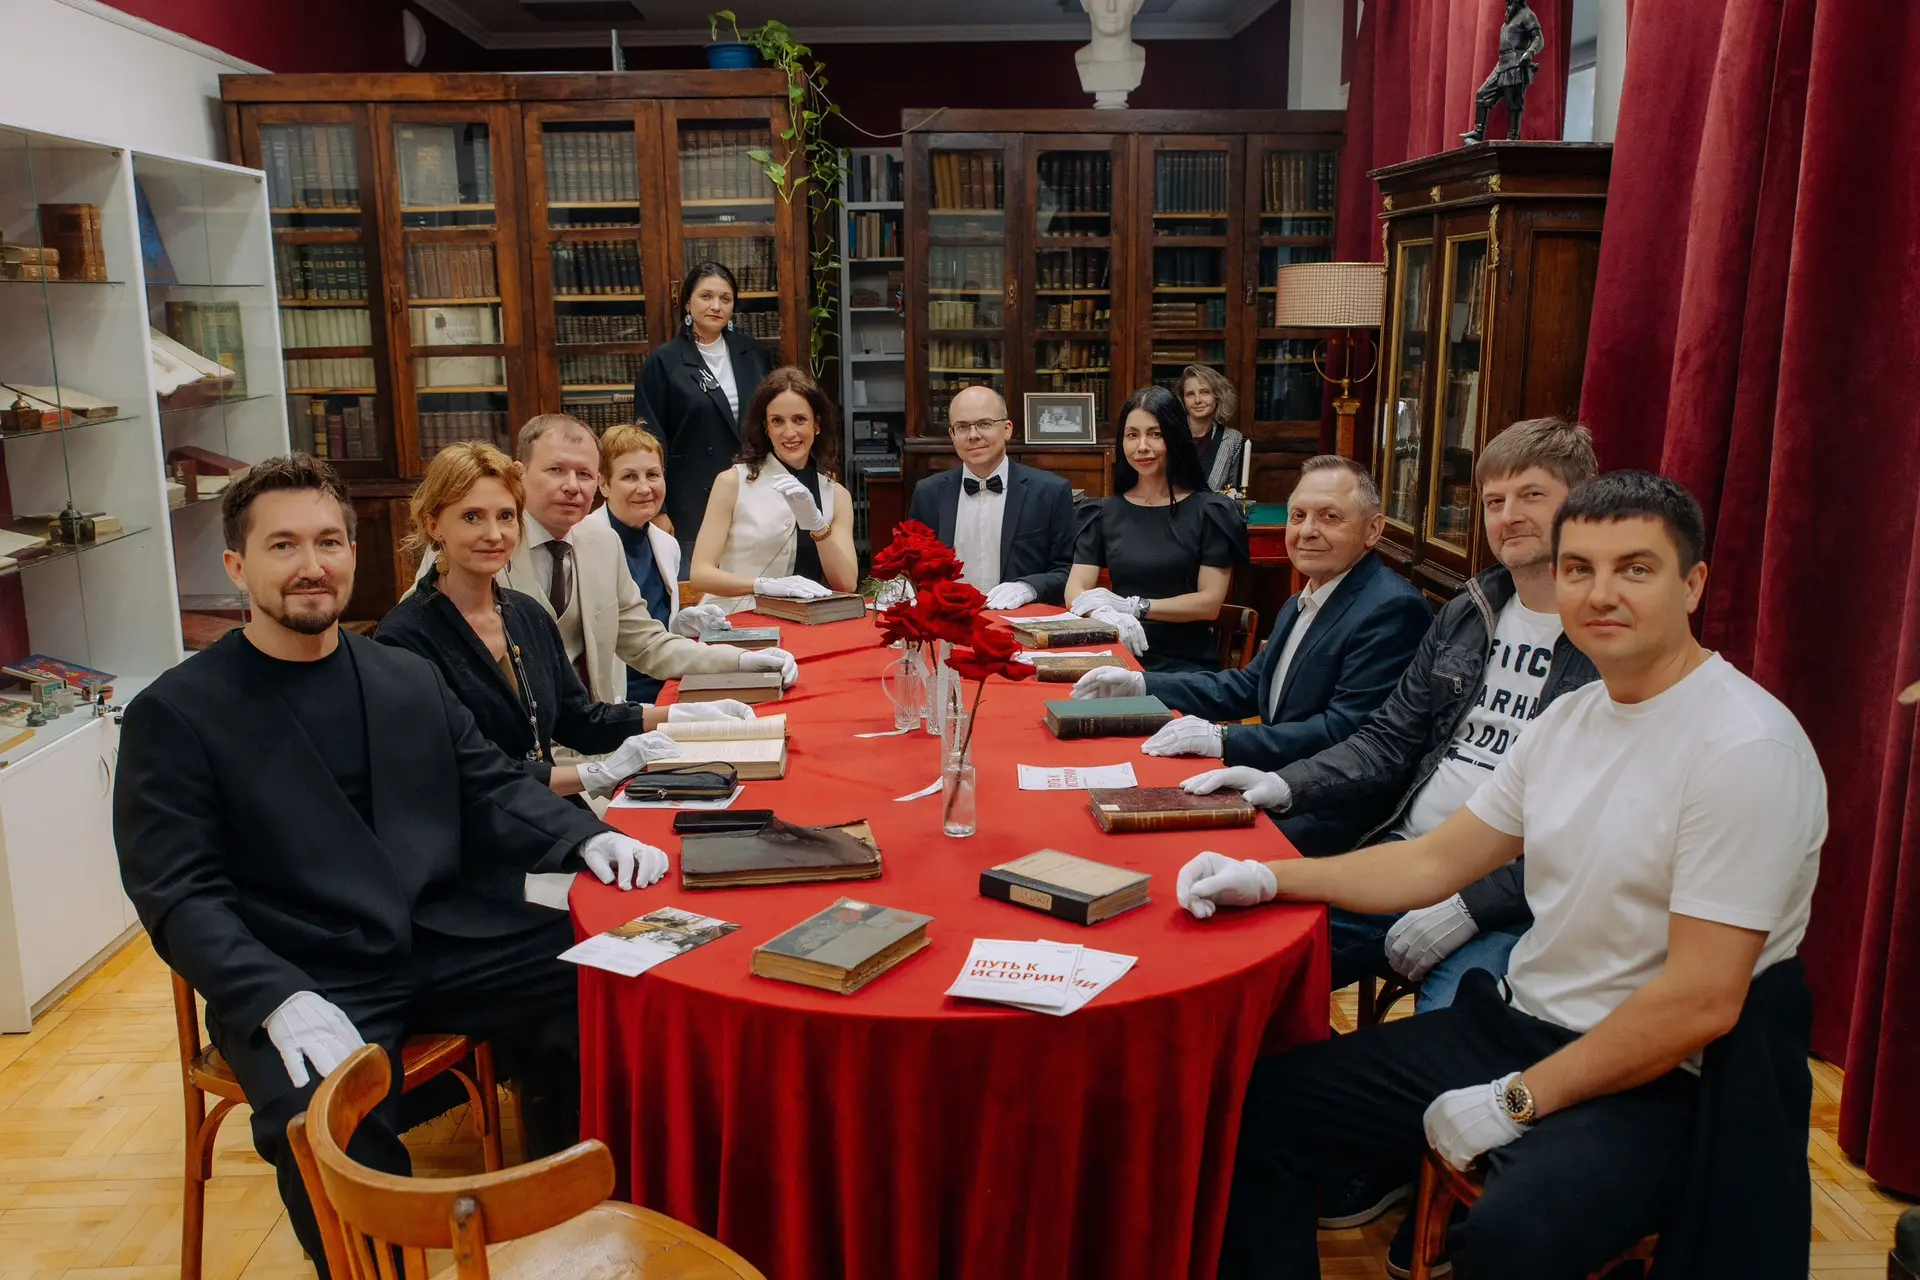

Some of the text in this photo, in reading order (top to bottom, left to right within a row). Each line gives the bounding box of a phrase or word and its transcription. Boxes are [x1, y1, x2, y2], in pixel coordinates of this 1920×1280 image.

[975, 960, 1039, 971] ПУТЬ К
[970, 970, 1065, 982] ИСТОРИИ
